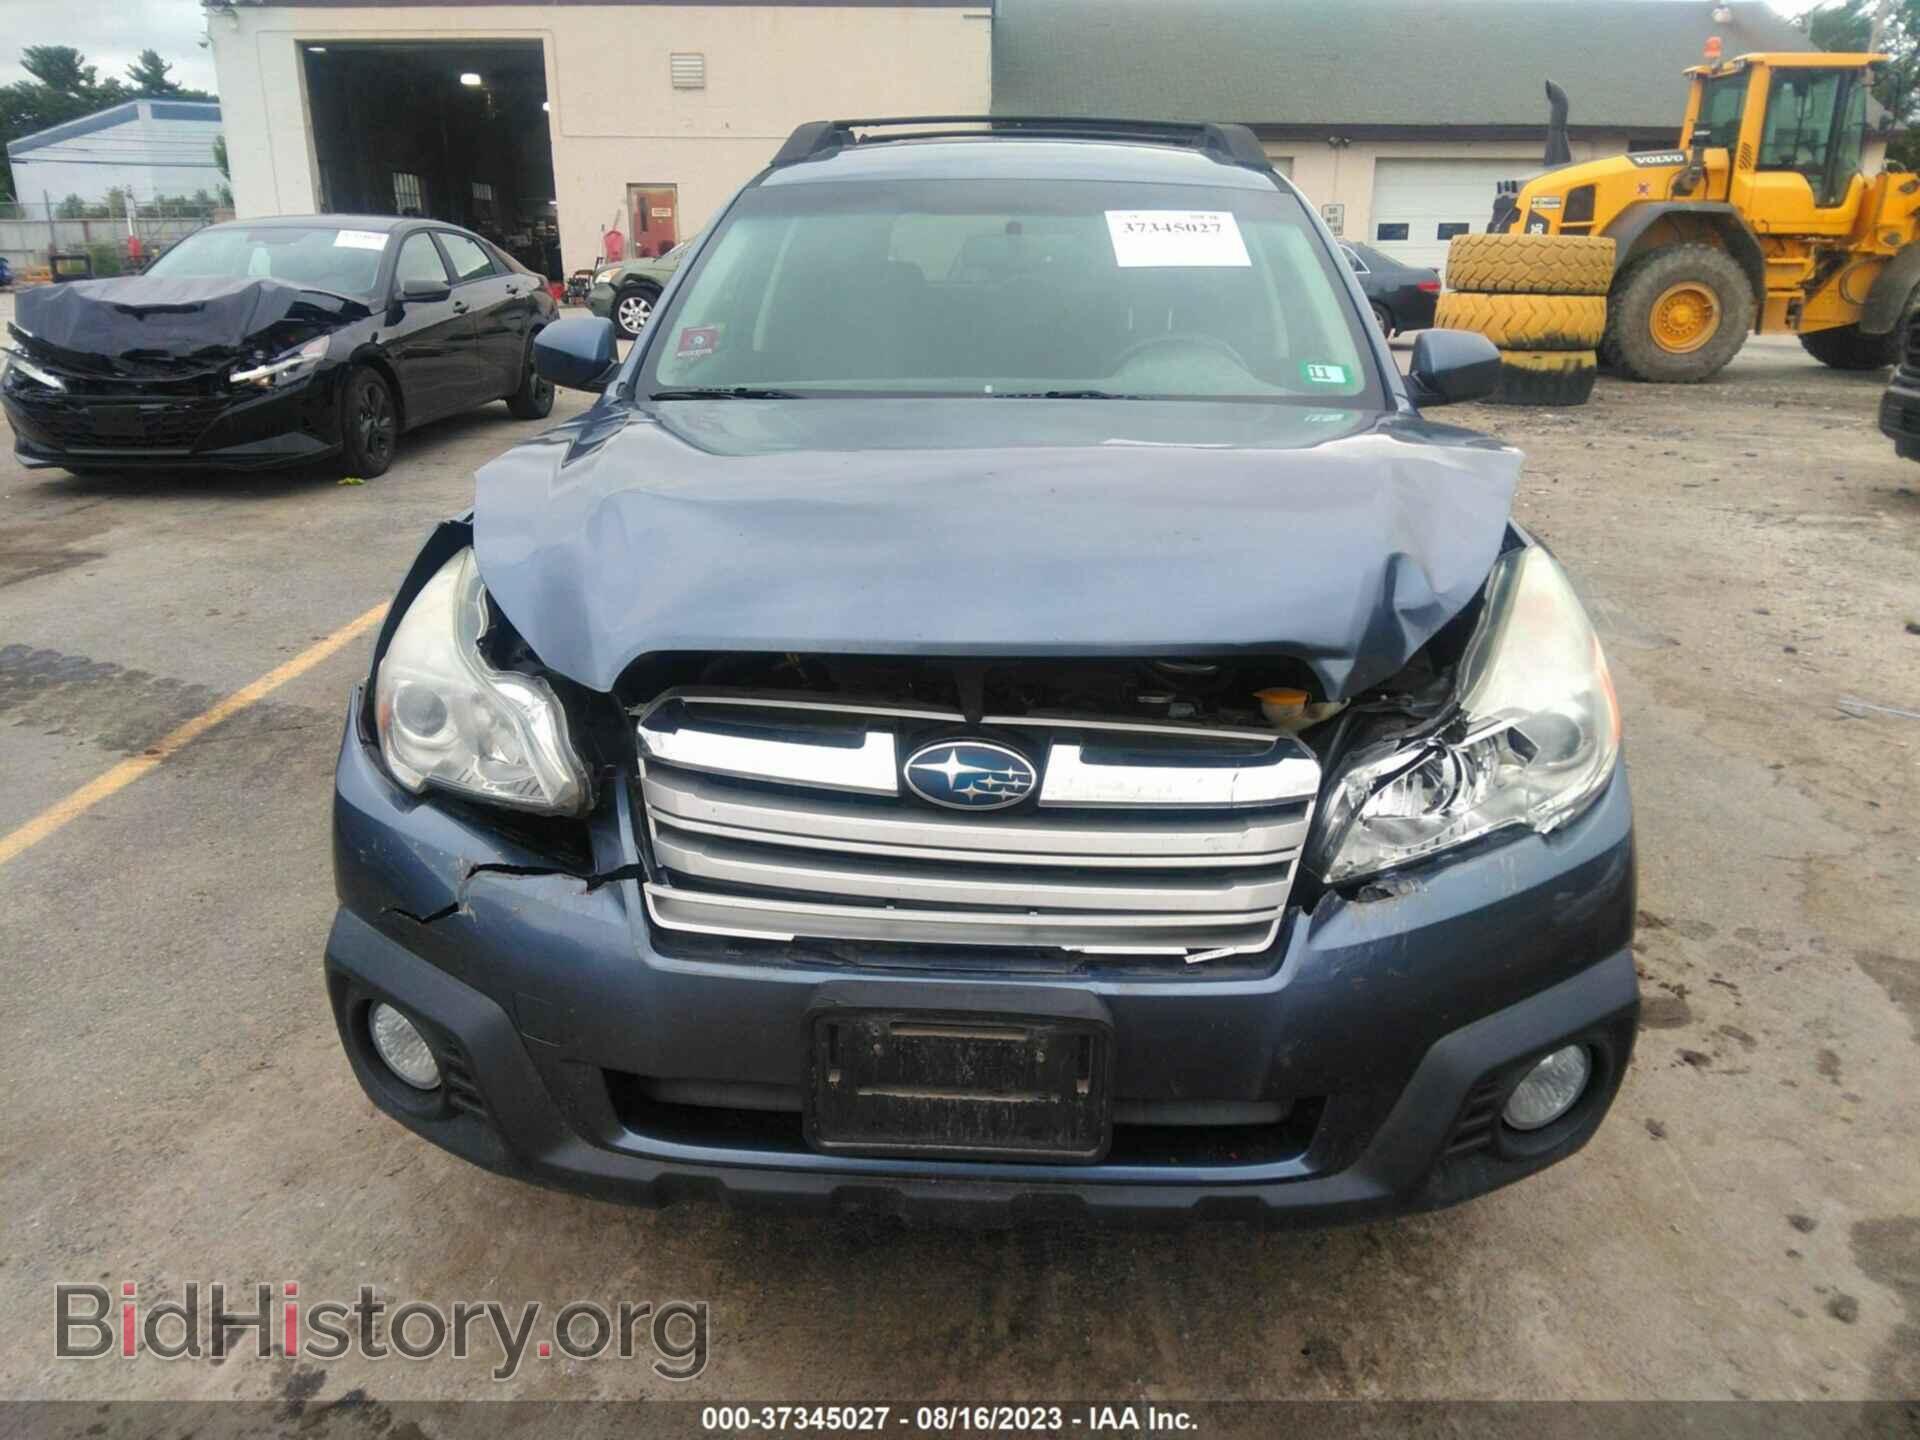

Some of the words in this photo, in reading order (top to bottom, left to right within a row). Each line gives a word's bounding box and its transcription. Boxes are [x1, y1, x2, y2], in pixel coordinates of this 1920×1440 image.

[1634, 154, 1684, 164] VOLVO
[1123, 221, 1223, 233] 37345027
[1310, 366, 1331, 379] 11
